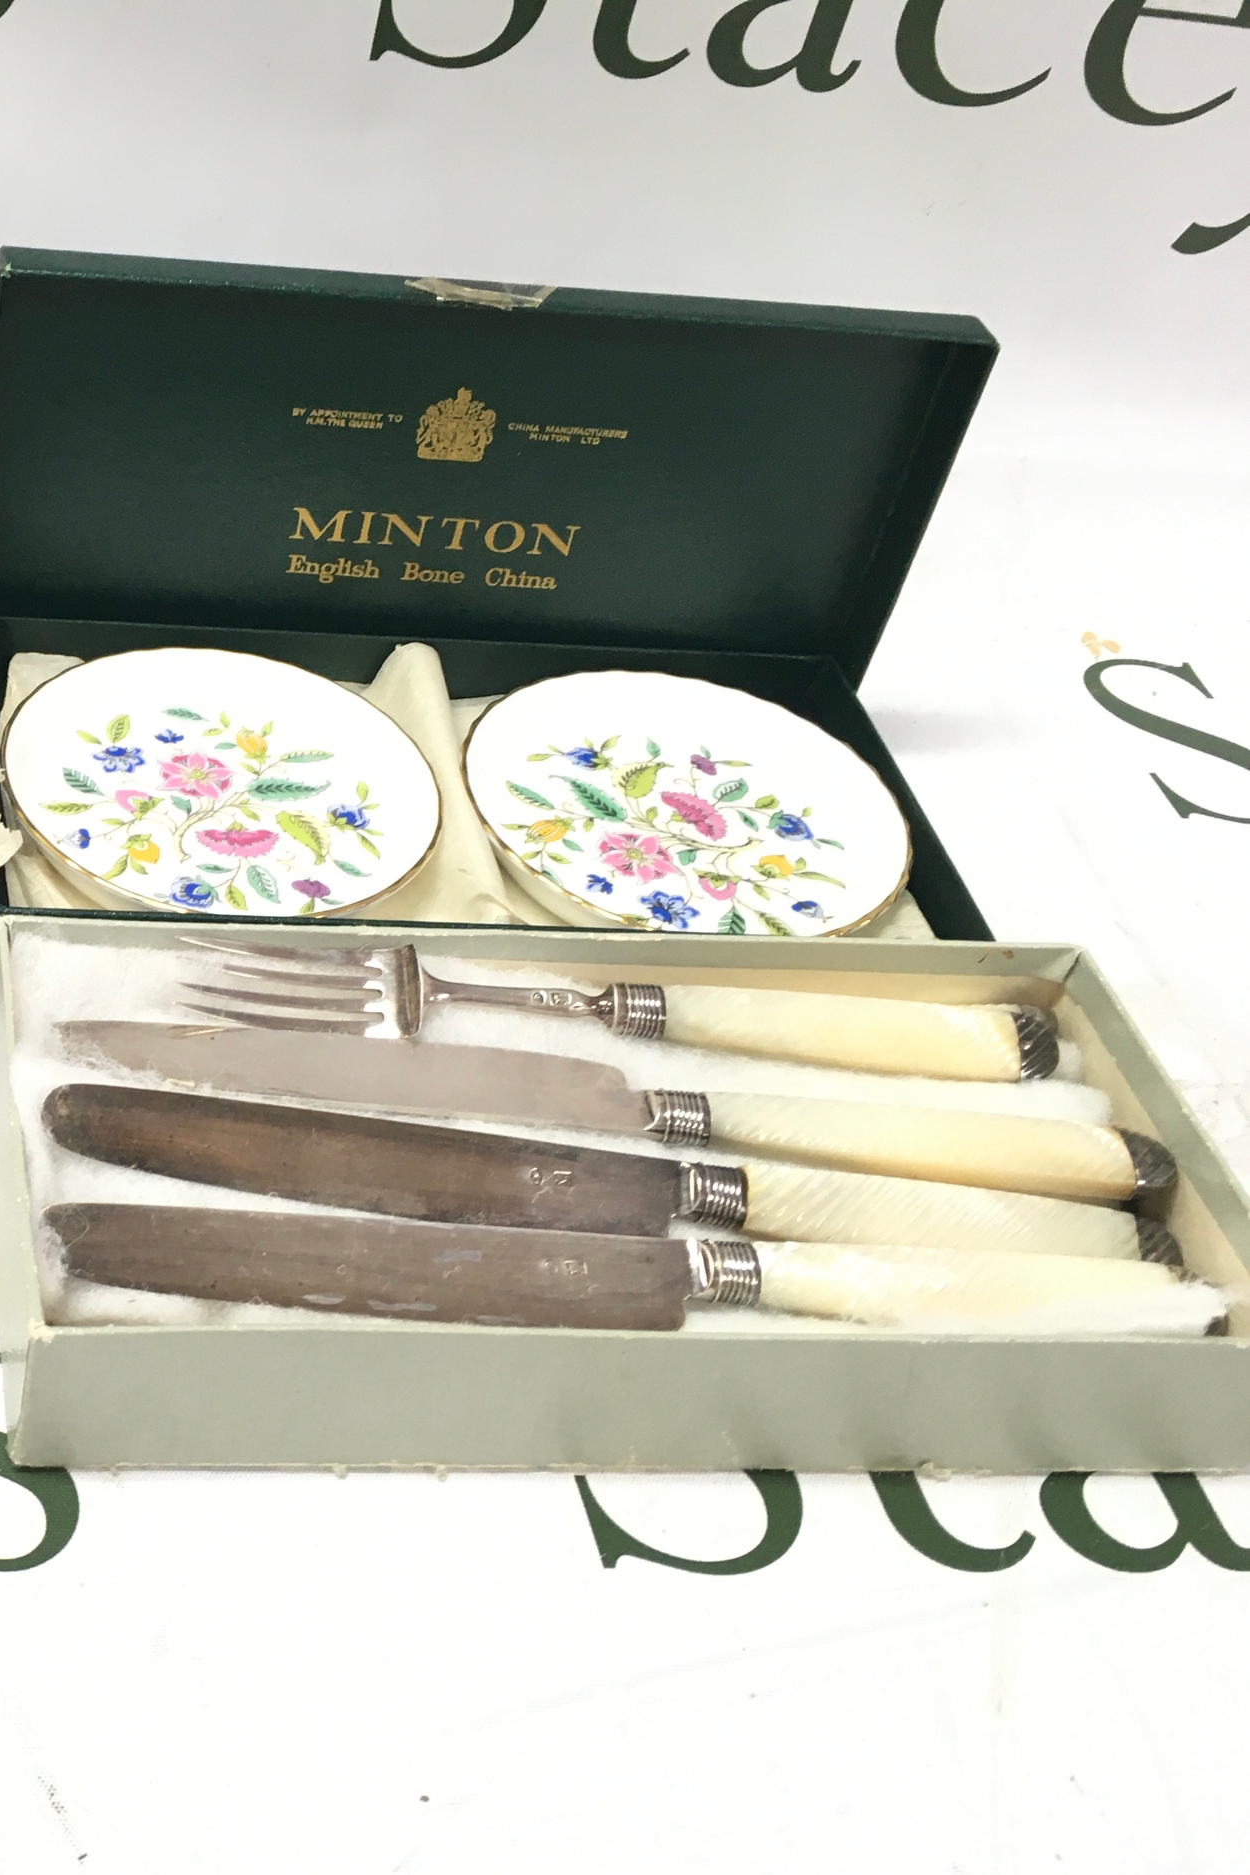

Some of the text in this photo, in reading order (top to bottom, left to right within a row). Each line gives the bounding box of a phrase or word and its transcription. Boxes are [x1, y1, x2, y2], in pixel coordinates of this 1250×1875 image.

[310, 409, 383, 421] APPOINTMENT
[388, 413, 404, 423] TO
[348, 419, 383, 430] QUEEN
[508, 422, 628, 440] CHINA MANUFACTURERS
[529, 433, 601, 446] MINTON LTD
[288, 505, 582, 557] MINTON
[286, 552, 558, 591] English Bone China
